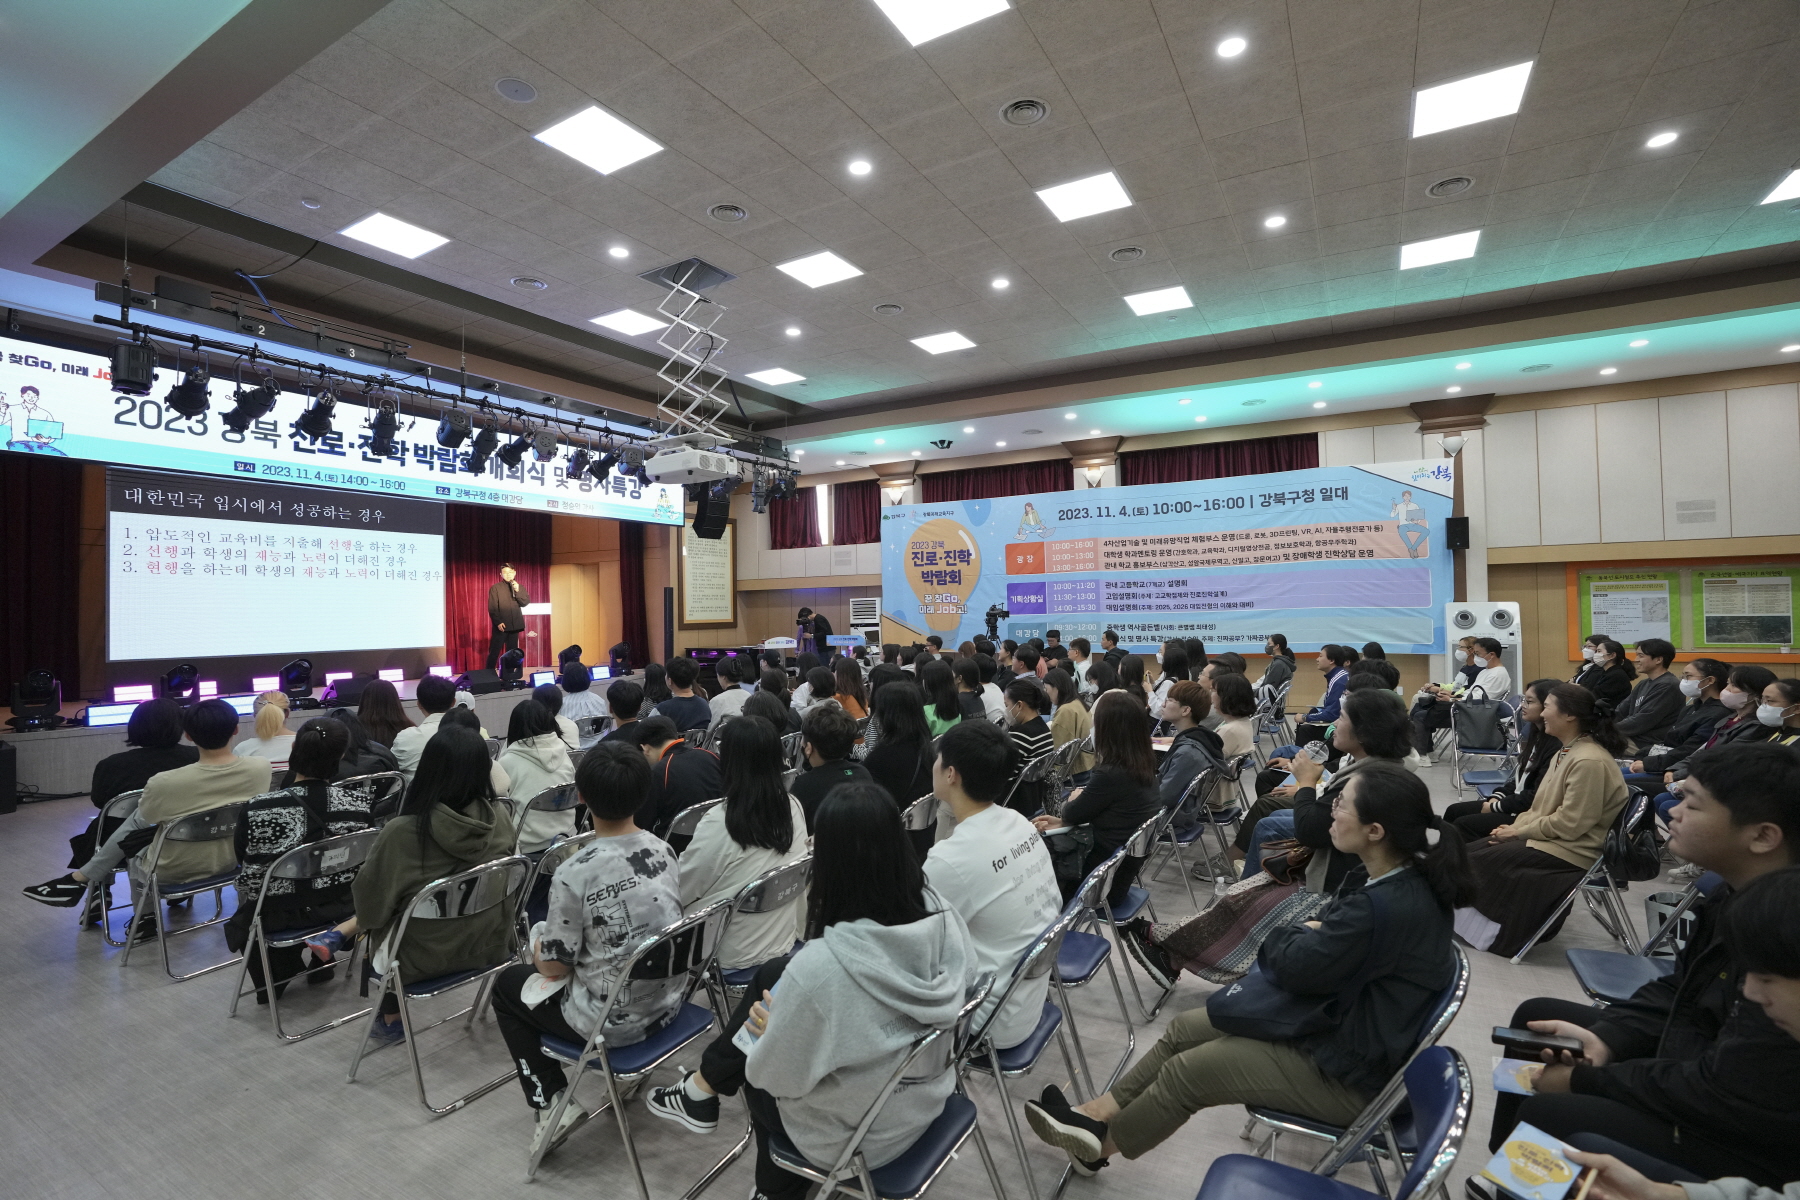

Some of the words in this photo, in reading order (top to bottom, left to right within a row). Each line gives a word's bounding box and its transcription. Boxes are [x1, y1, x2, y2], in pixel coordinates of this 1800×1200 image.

[151, 299, 157, 310] 1
[258, 325, 266, 336] 2
[349, 348, 356, 358] 3
[8, 353, 57, 373] 찾Go,
[61, 362, 89, 377] 미래
[114, 396, 208, 436] 2023
[1430, 465, 1452, 482] 강북
[235, 462, 254, 472] 일시
[261, 464, 294, 479] 2023.
[296, 468, 312, 481] 11.
[340, 473, 369, 486] 14:00
[379, 478, 406, 491] 16:00
[501, 494, 524, 505] 대강당
[124, 487, 205, 509] 대한민국
[213, 495, 282, 516] 입시에서
[290, 502, 352, 521] 성공하는
[358, 508, 386, 524] 경우
[1058, 507, 1093, 521] 2023.
[1096, 506, 1116, 518] 11.
[1119, 504, 1149, 518] 4.(토)
[1152, 496, 1245, 515] 10:00~16:00
[1258, 488, 1316, 507] 강북구청
[1320, 486, 1349, 502] 일대
[124, 527, 138, 540] 1.
[146, 528, 211, 544] 압도적인
[219, 532, 277, 547] 교육비를
[283, 535, 322, 549] 지출해
[328, 538, 364, 552] 선행을
[369, 541, 392, 553] 하는
[397, 542, 417, 554] 경우
[911, 541, 930, 550] 2023
[1051, 541, 1094, 550] 10:00~16:00
[1103, 538, 1140, 547] 4차산업기술
[123, 543, 138, 556] 2.
[146, 543, 196, 559] 선행과
[203, 546, 247, 561] 학생의
[255, 549, 296, 563] 재능과
[302, 551, 339, 565] 노력이
[345, 554, 380, 567] 더해진
[385, 555, 407, 567] 경우
[911, 549, 972, 567] 진로·진학
[1052, 552, 1094, 561] 10:00~13:00
[1103, 551, 1123, 559] 대학생
[122, 560, 138, 574] 3.
[146, 560, 196, 575] 현행을
[203, 563, 247, 577] 하는데
[255, 564, 295, 578] 학생의
[302, 566, 340, 579] 재능과
[345, 567, 379, 580] 노력이
[385, 569, 417, 581] 더해진
[422, 570, 443, 582] 경우
[1052, 562, 1095, 571] 13:00~16:00
[921, 569, 962, 586] 박람회
[1053, 581, 1096, 590] 10:00~11:20
[1167, 579, 1188, 588] 설명회
[1053, 592, 1096, 601] 11:30~13:00
[918, 605, 935, 614] 미래
[1053, 604, 1096, 612] 14:00~15:30
[991, 855, 1008, 873] for
[1009, 841, 1031, 860] living
